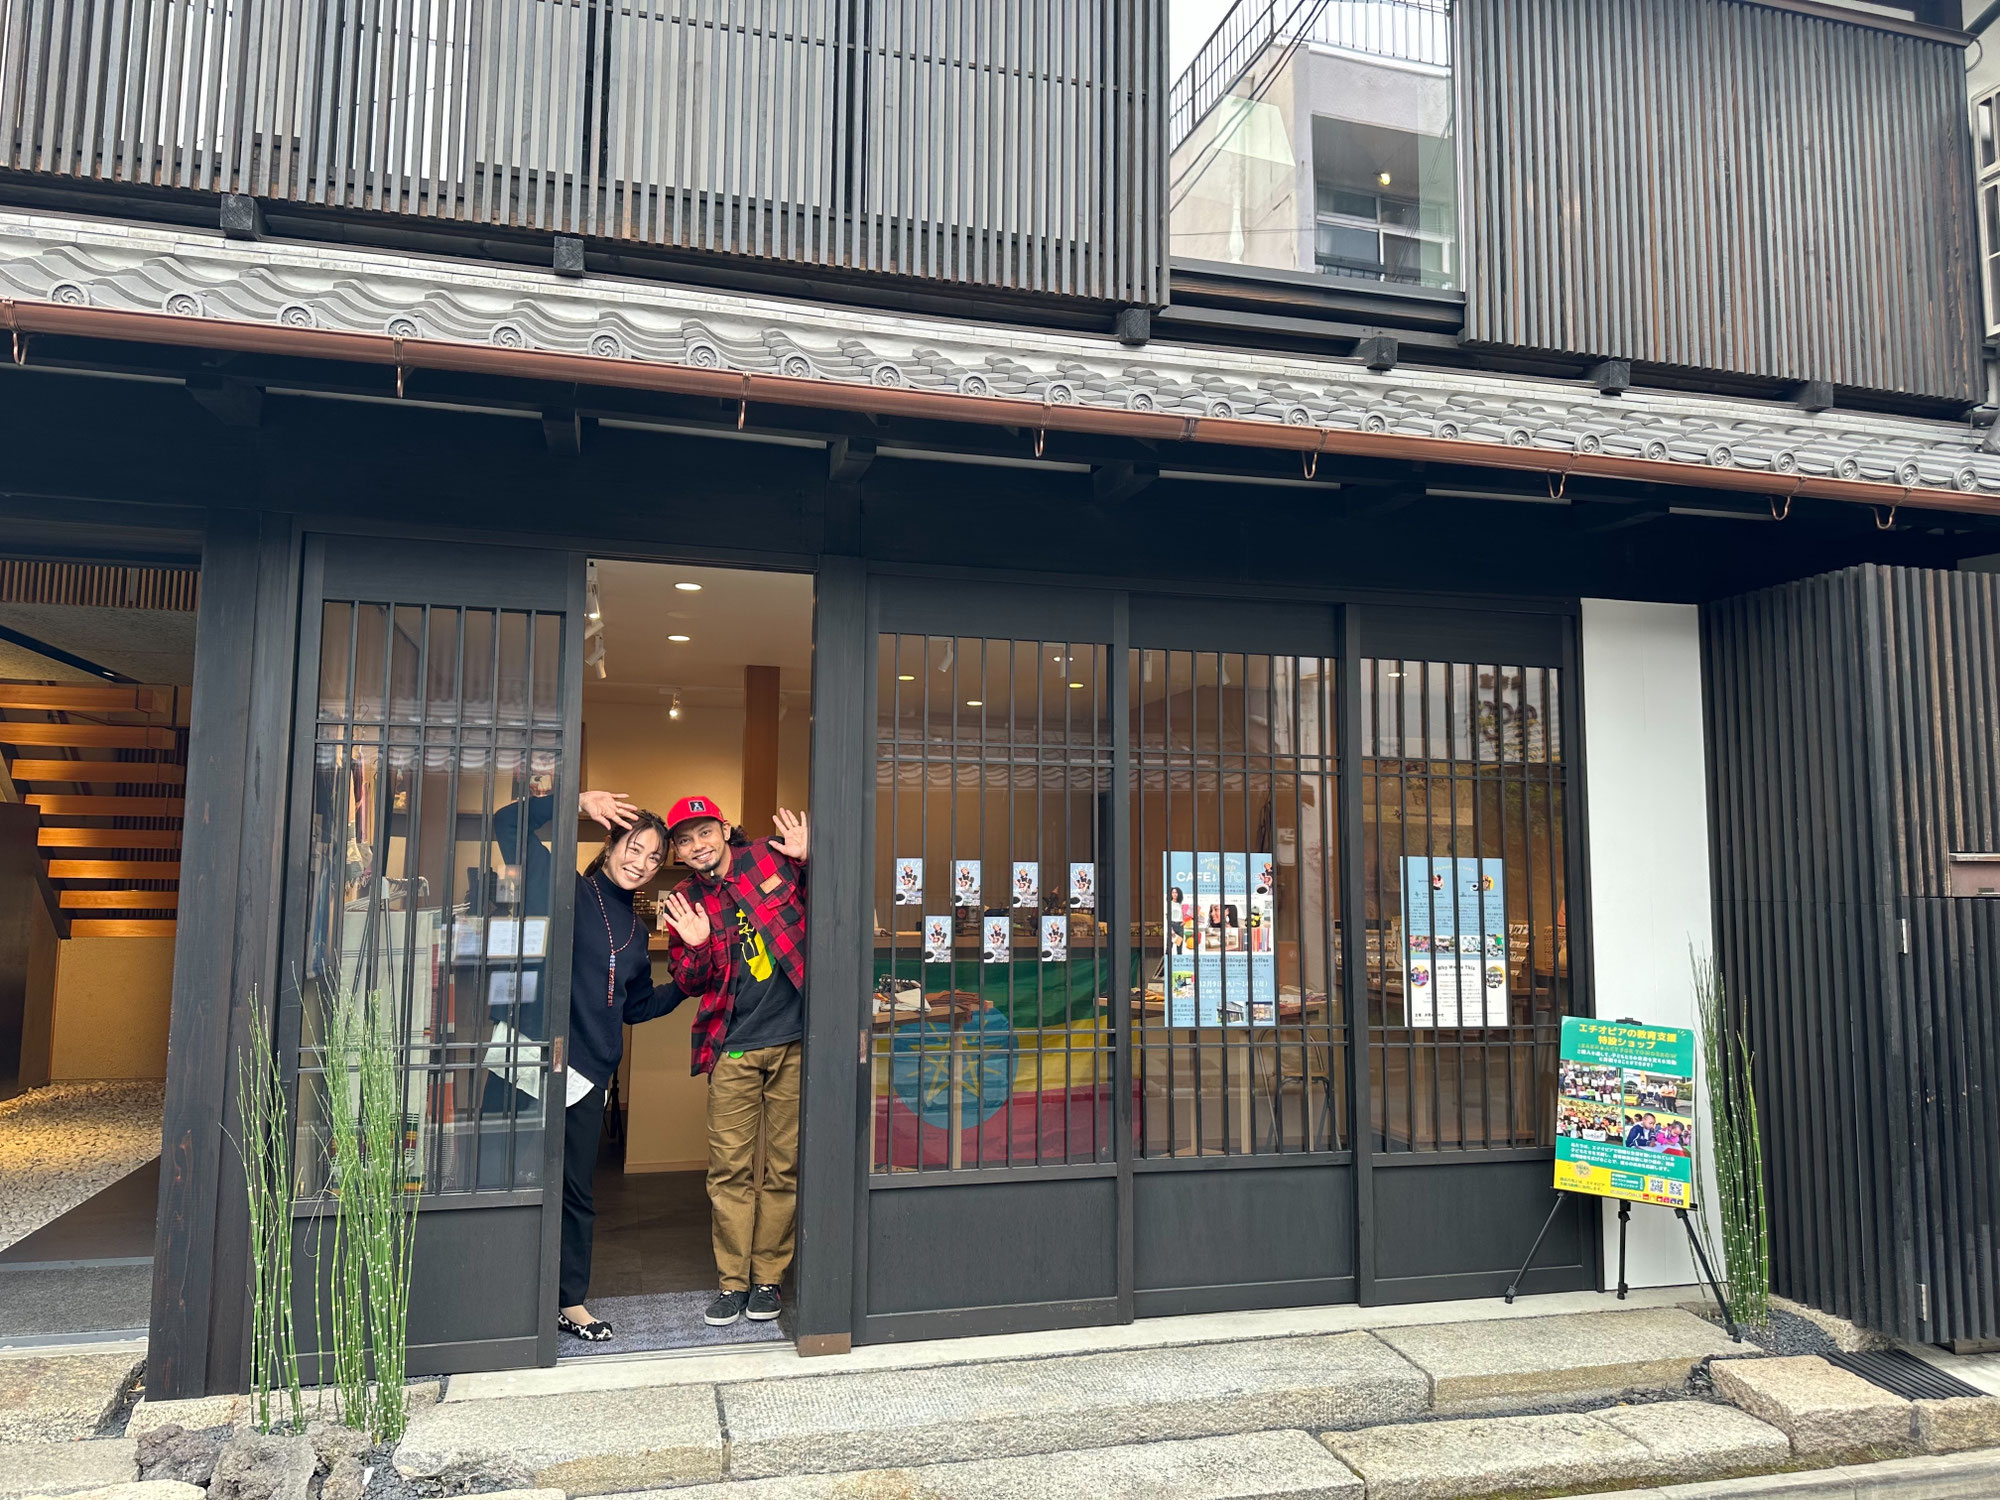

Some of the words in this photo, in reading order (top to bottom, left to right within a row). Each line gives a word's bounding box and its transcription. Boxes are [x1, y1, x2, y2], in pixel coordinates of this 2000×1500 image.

[1176, 871, 1212, 882] CAFE
[1579, 1024, 1676, 1043] エチオピアの教育支援
[1598, 1035, 1655, 1050] 特設ショップ
